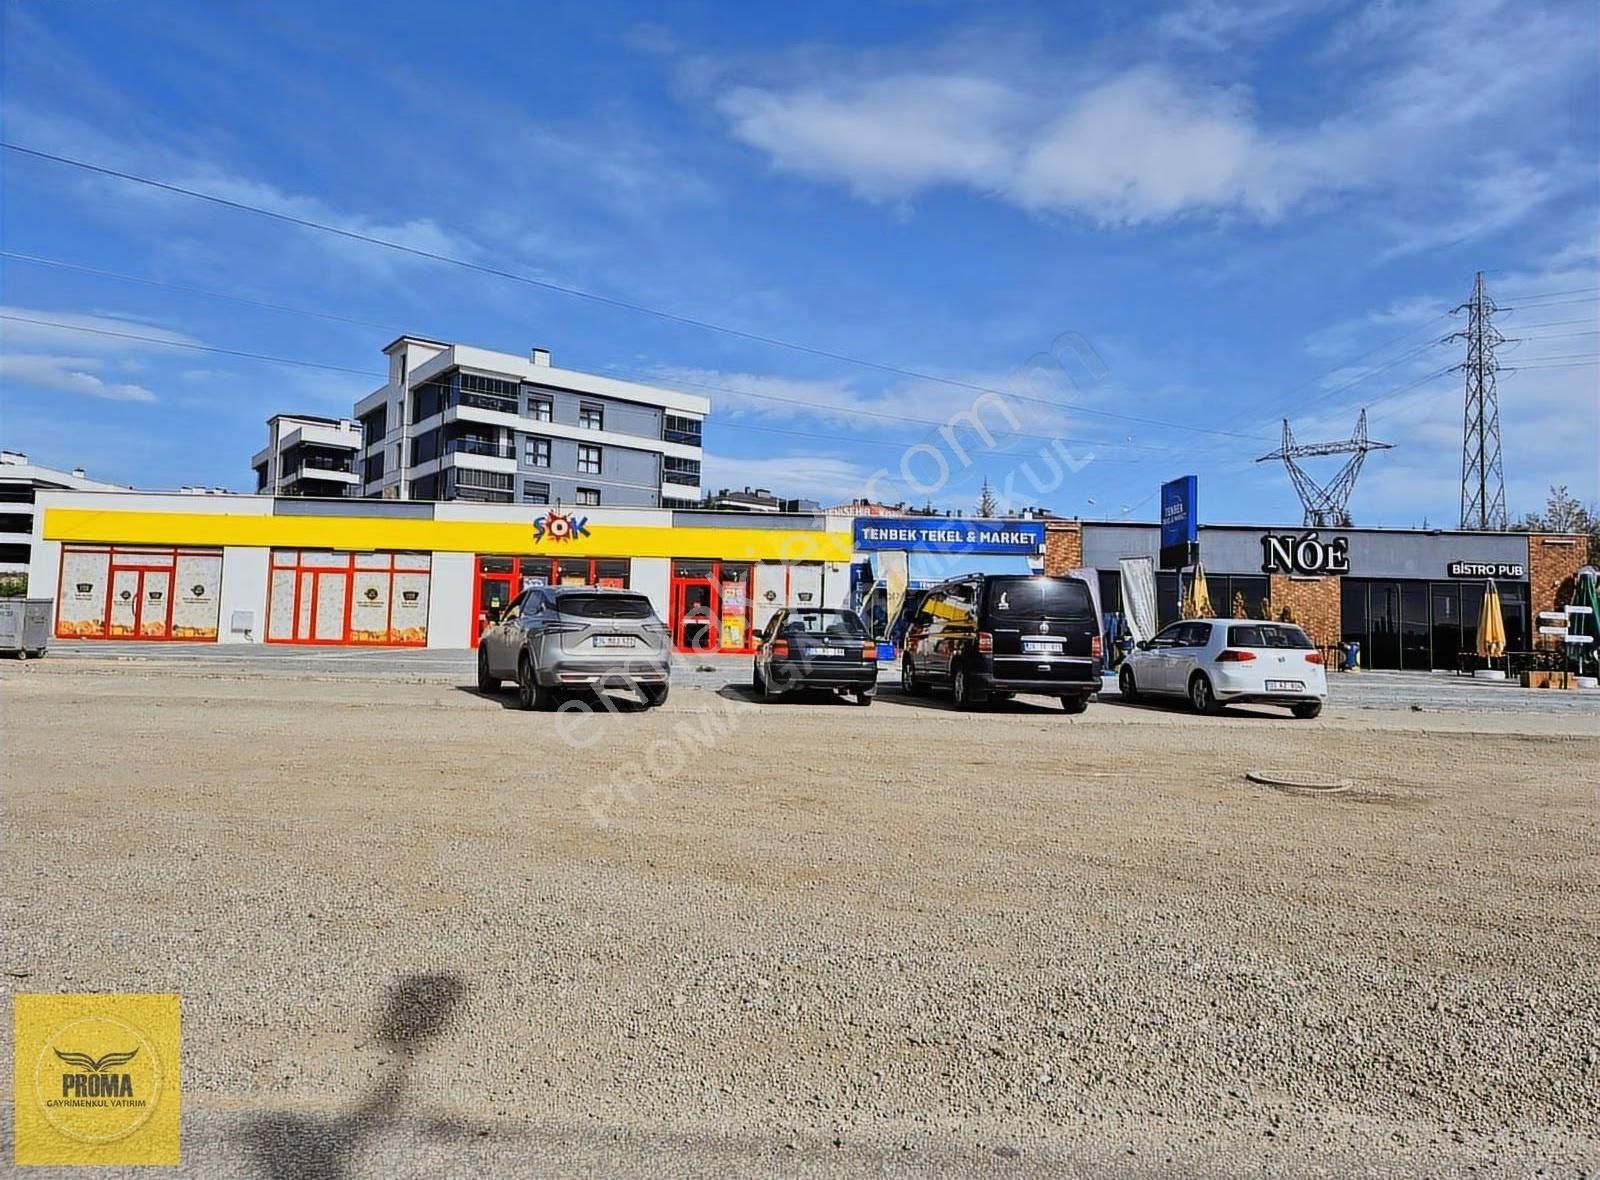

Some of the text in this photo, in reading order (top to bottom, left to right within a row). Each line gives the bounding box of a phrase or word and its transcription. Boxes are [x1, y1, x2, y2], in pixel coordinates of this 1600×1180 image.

[861, 528, 1038, 545] TENBEK TEKEL & MARKET
[1266, 532, 1349, 571] NÓE
[1452, 562, 1524, 577] BİSTRO PUB
